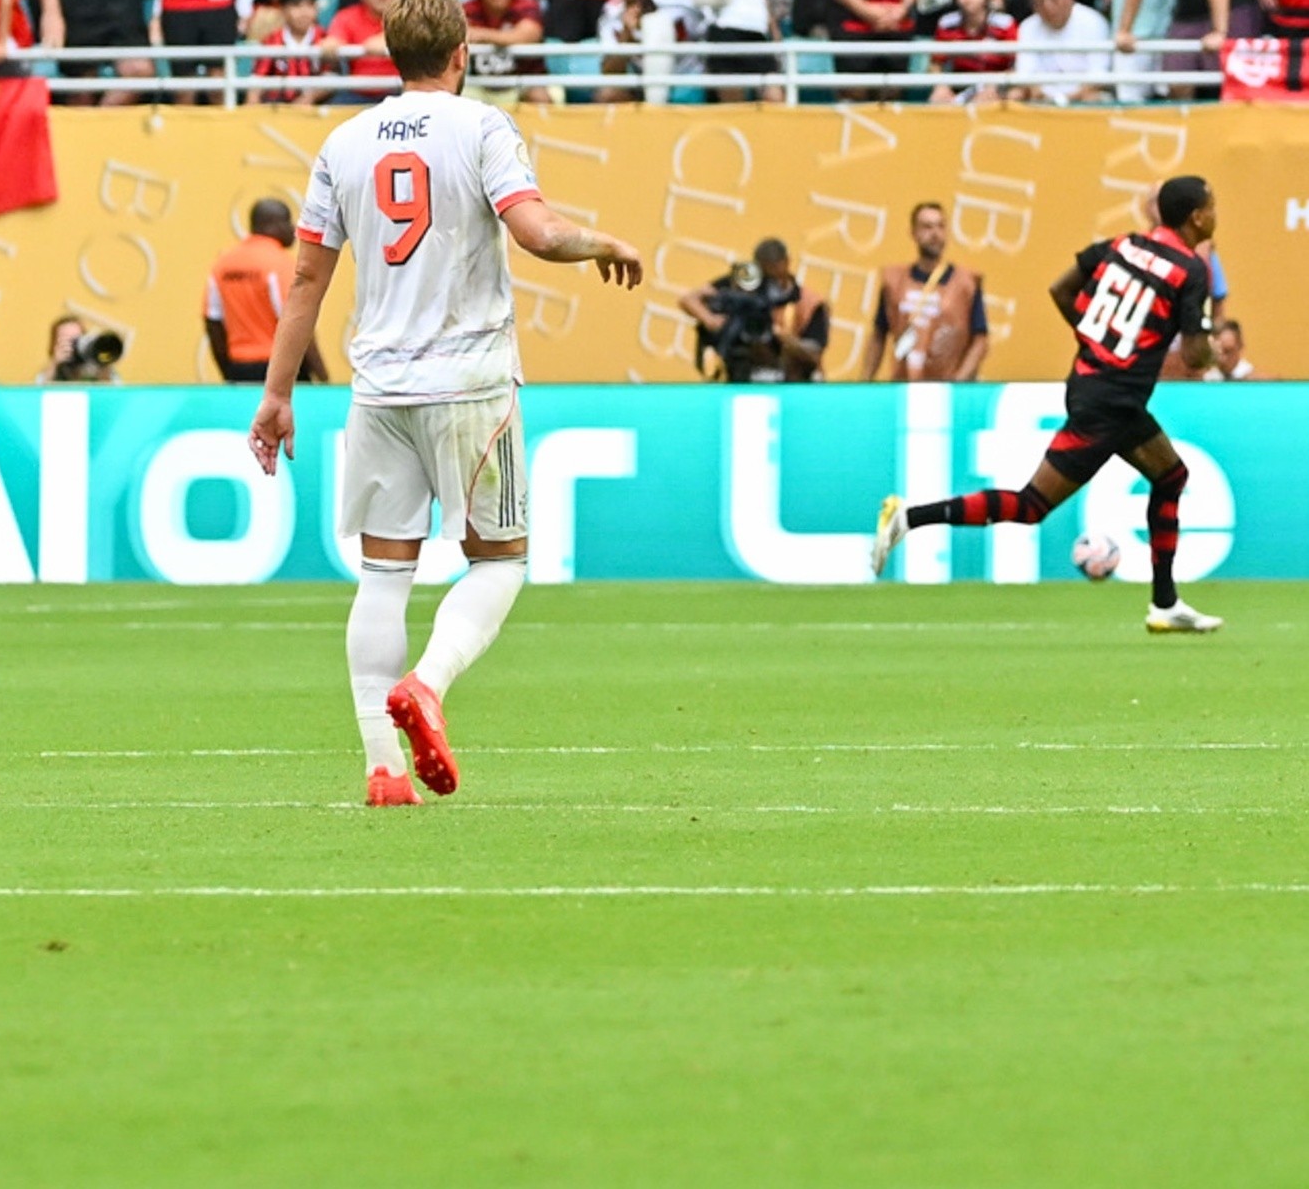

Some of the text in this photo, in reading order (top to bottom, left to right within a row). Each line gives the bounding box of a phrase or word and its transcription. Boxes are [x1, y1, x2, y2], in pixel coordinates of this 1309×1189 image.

[376, 114, 432, 142] KANE
[374, 151, 433, 265] 9
[1078, 261, 1156, 360] 64
[720, 384, 1236, 584] Life
